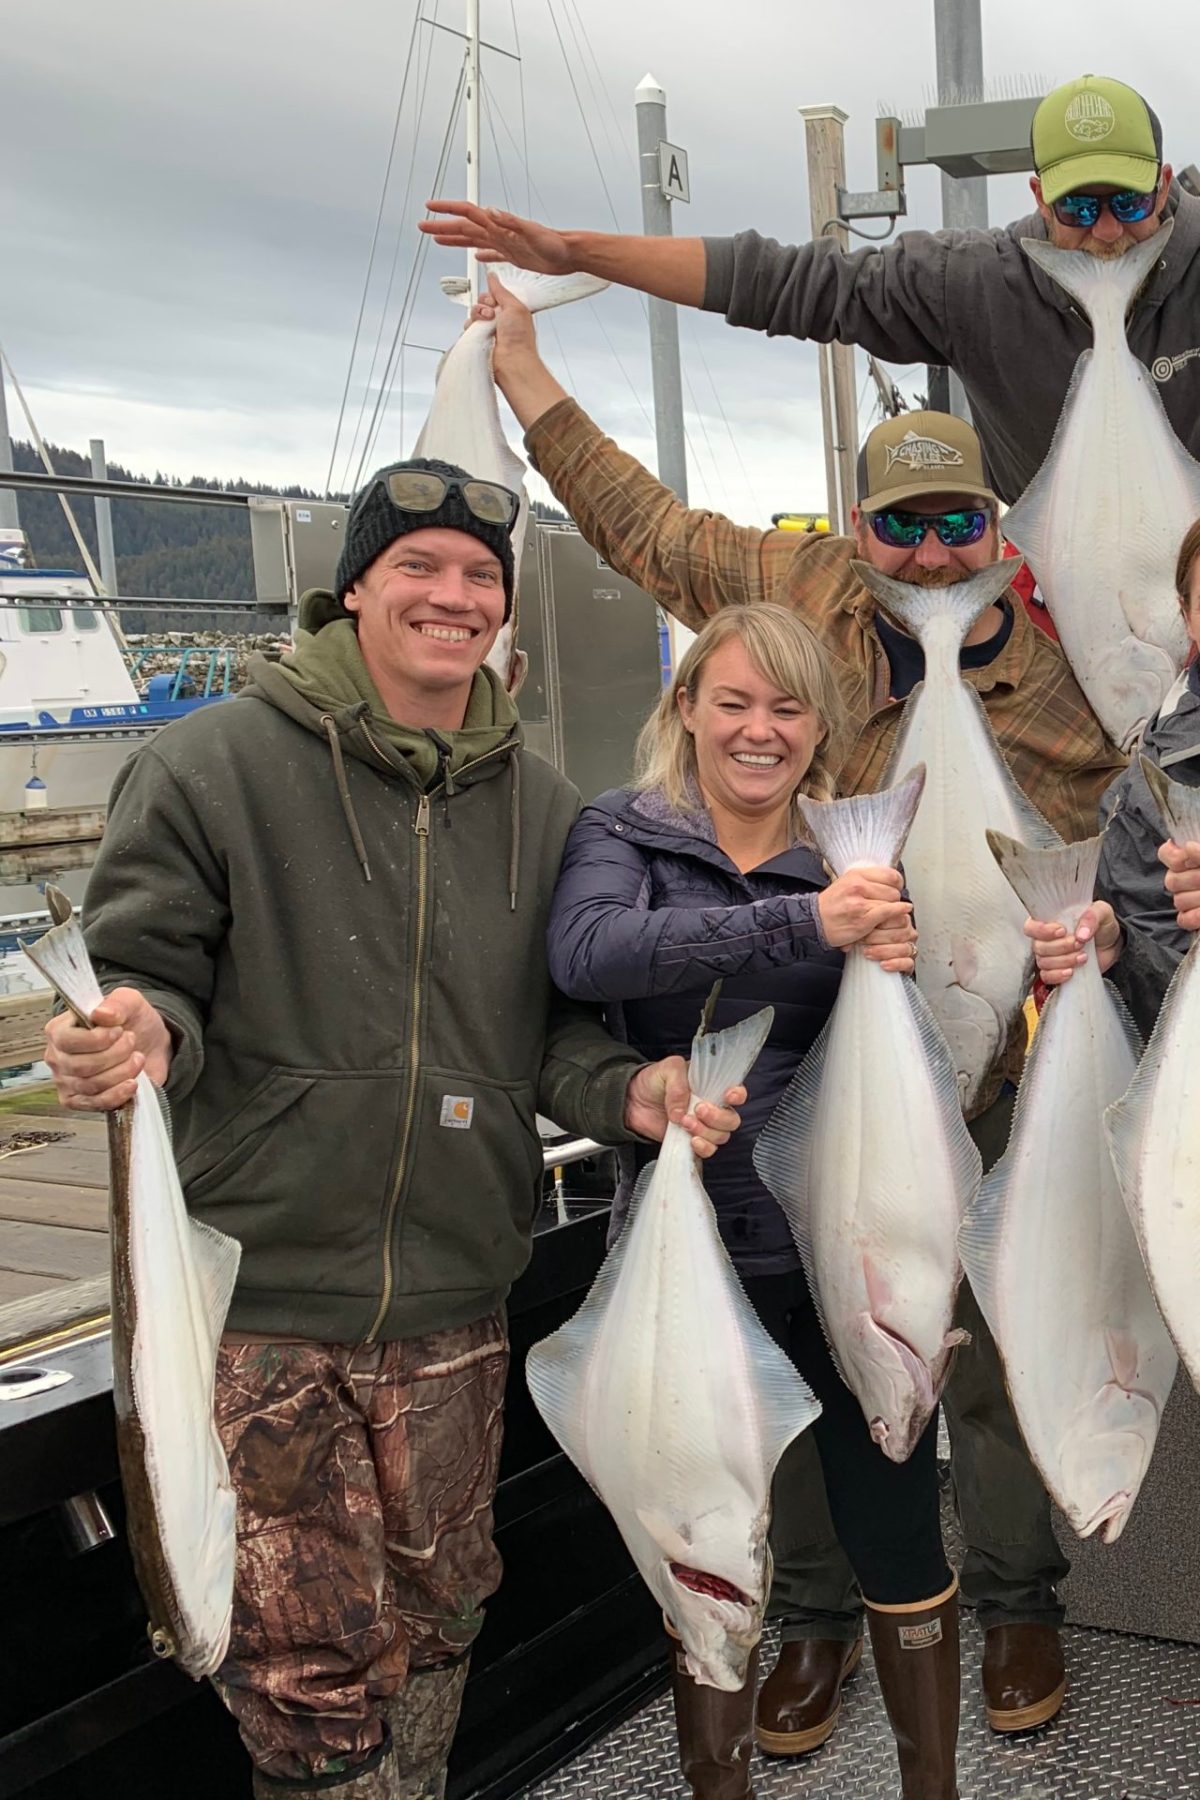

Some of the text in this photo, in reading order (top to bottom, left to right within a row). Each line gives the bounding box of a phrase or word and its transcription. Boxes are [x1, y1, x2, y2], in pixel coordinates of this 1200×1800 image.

[668, 154, 683, 192] A
[900, 441, 940, 457] CHASING
[910, 452, 941, 463] TALES
[901, 1622, 938, 1639] XTRATUF
